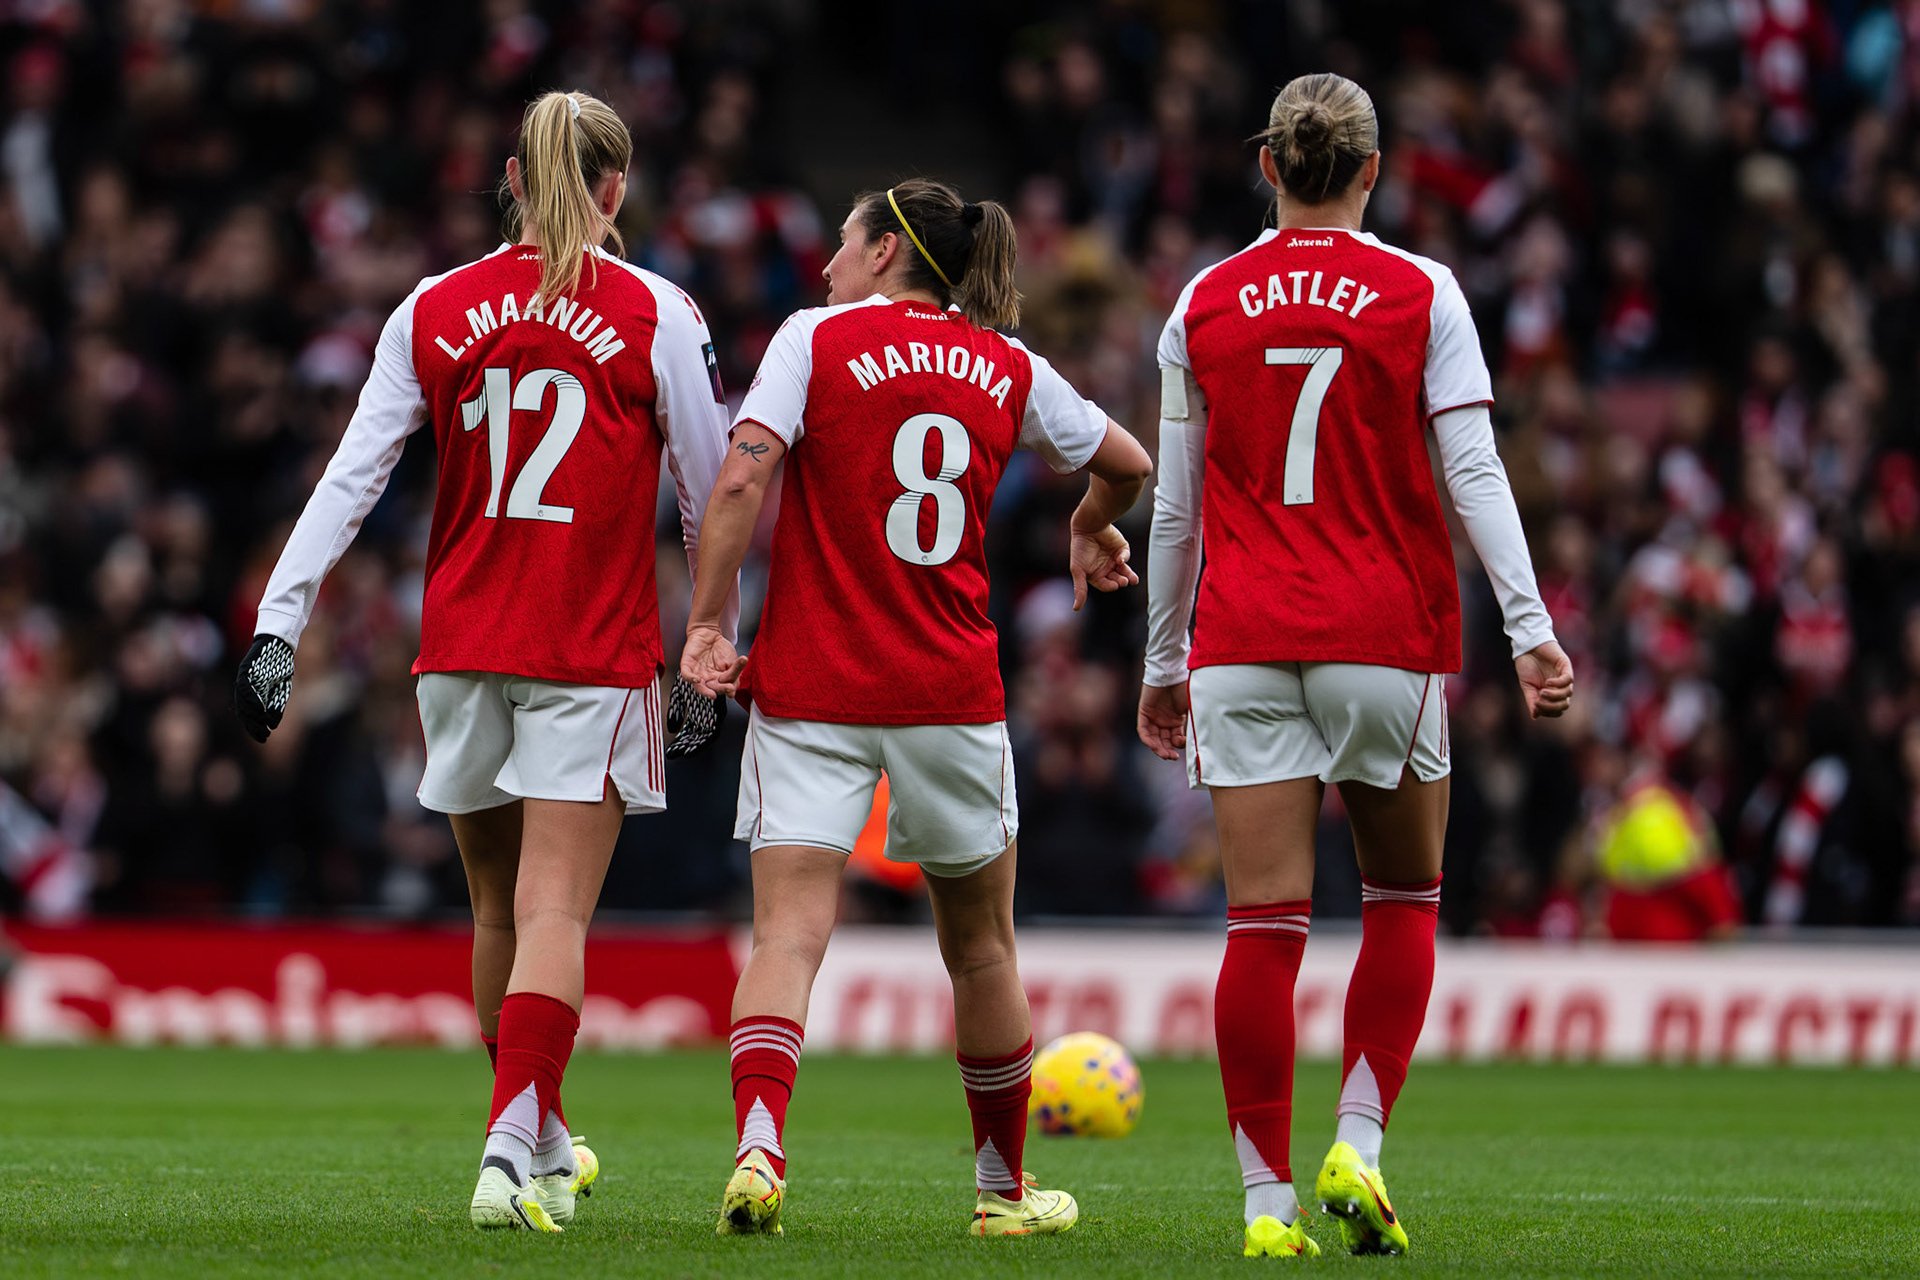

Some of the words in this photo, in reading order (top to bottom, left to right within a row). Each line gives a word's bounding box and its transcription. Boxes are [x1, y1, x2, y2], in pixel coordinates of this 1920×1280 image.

[1286, 236, 1334, 248] Arsenal
[434, 292, 627, 365] L.MAANUM
[904, 308, 949, 321] Arsenal
[1238, 270, 1380, 319] CATLEY
[846, 341, 1013, 410] MARIONA
[460, 367, 587, 525] 12
[1264, 346, 1344, 506] 7
[885, 412, 972, 567] 8
